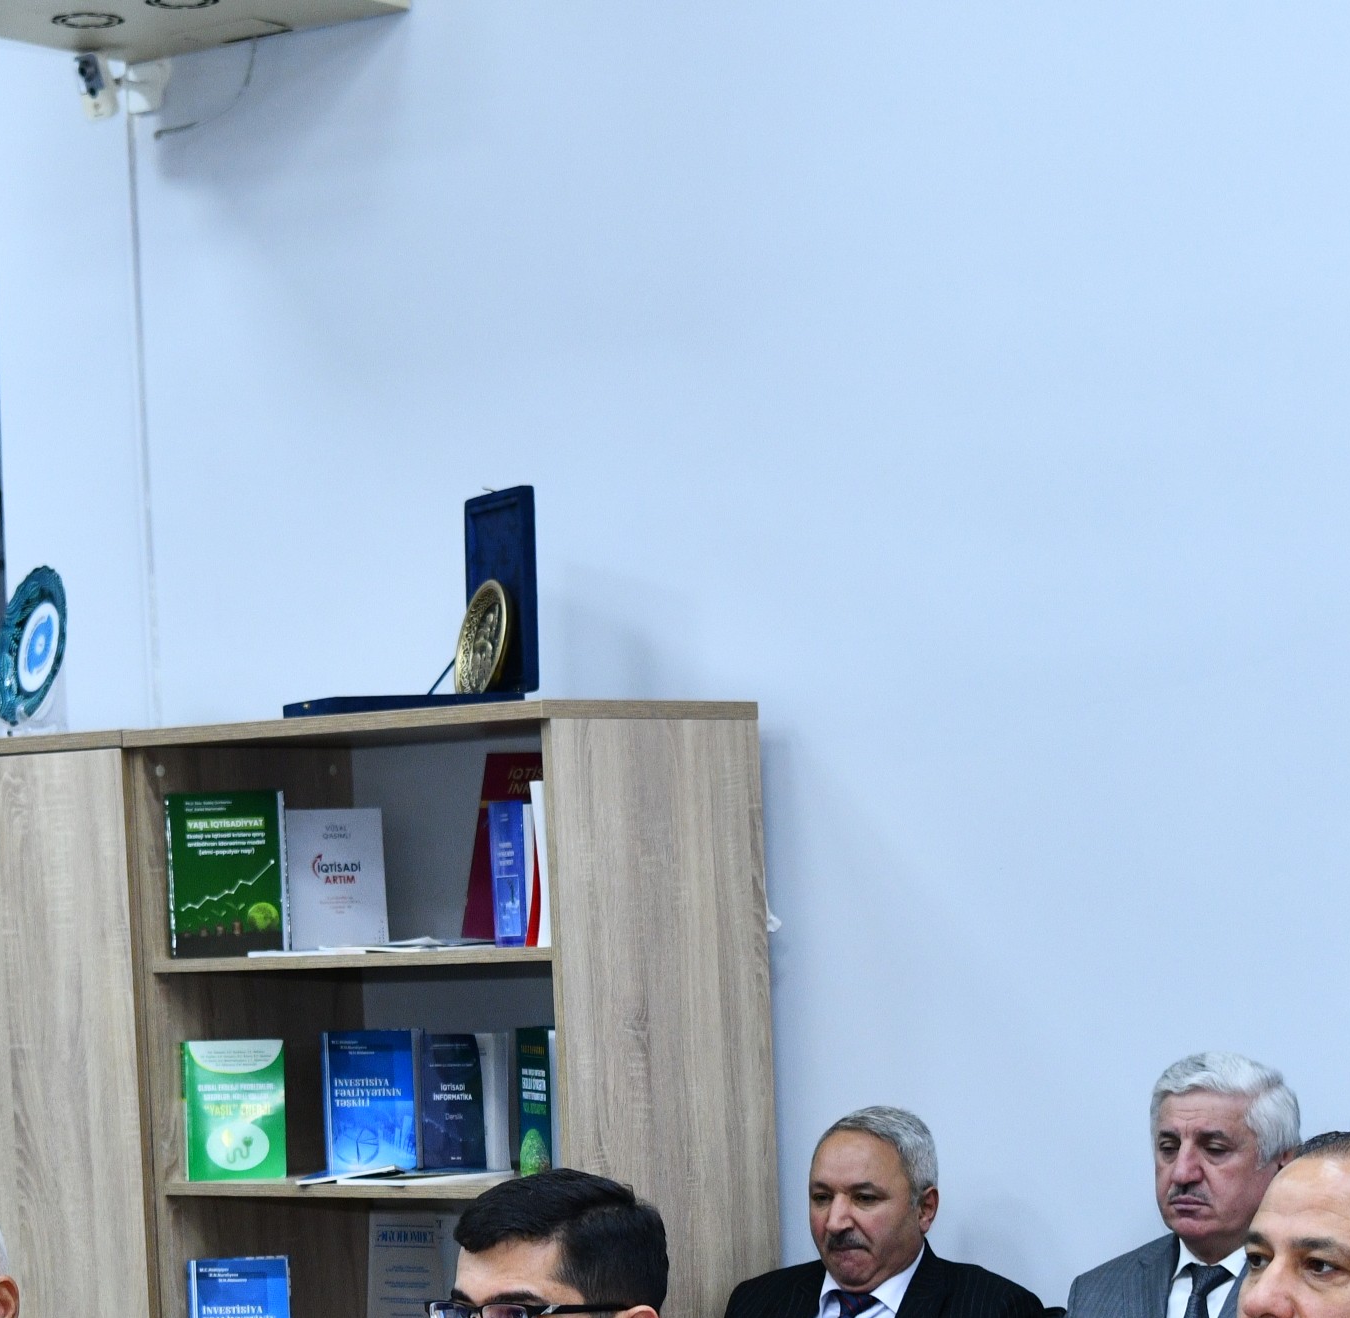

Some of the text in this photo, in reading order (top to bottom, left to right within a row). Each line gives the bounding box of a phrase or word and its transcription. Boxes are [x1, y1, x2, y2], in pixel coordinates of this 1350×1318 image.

[187, 821, 210, 831] YAŞIL
[325, 875, 356, 885] ARTIM
[334, 1077, 389, 1087] İNVESTİSİYA
[335, 1088, 402, 1098] FƏALİYYƏTİNİN
[202, 1304, 263, 1315] İNVESTİSİYA
